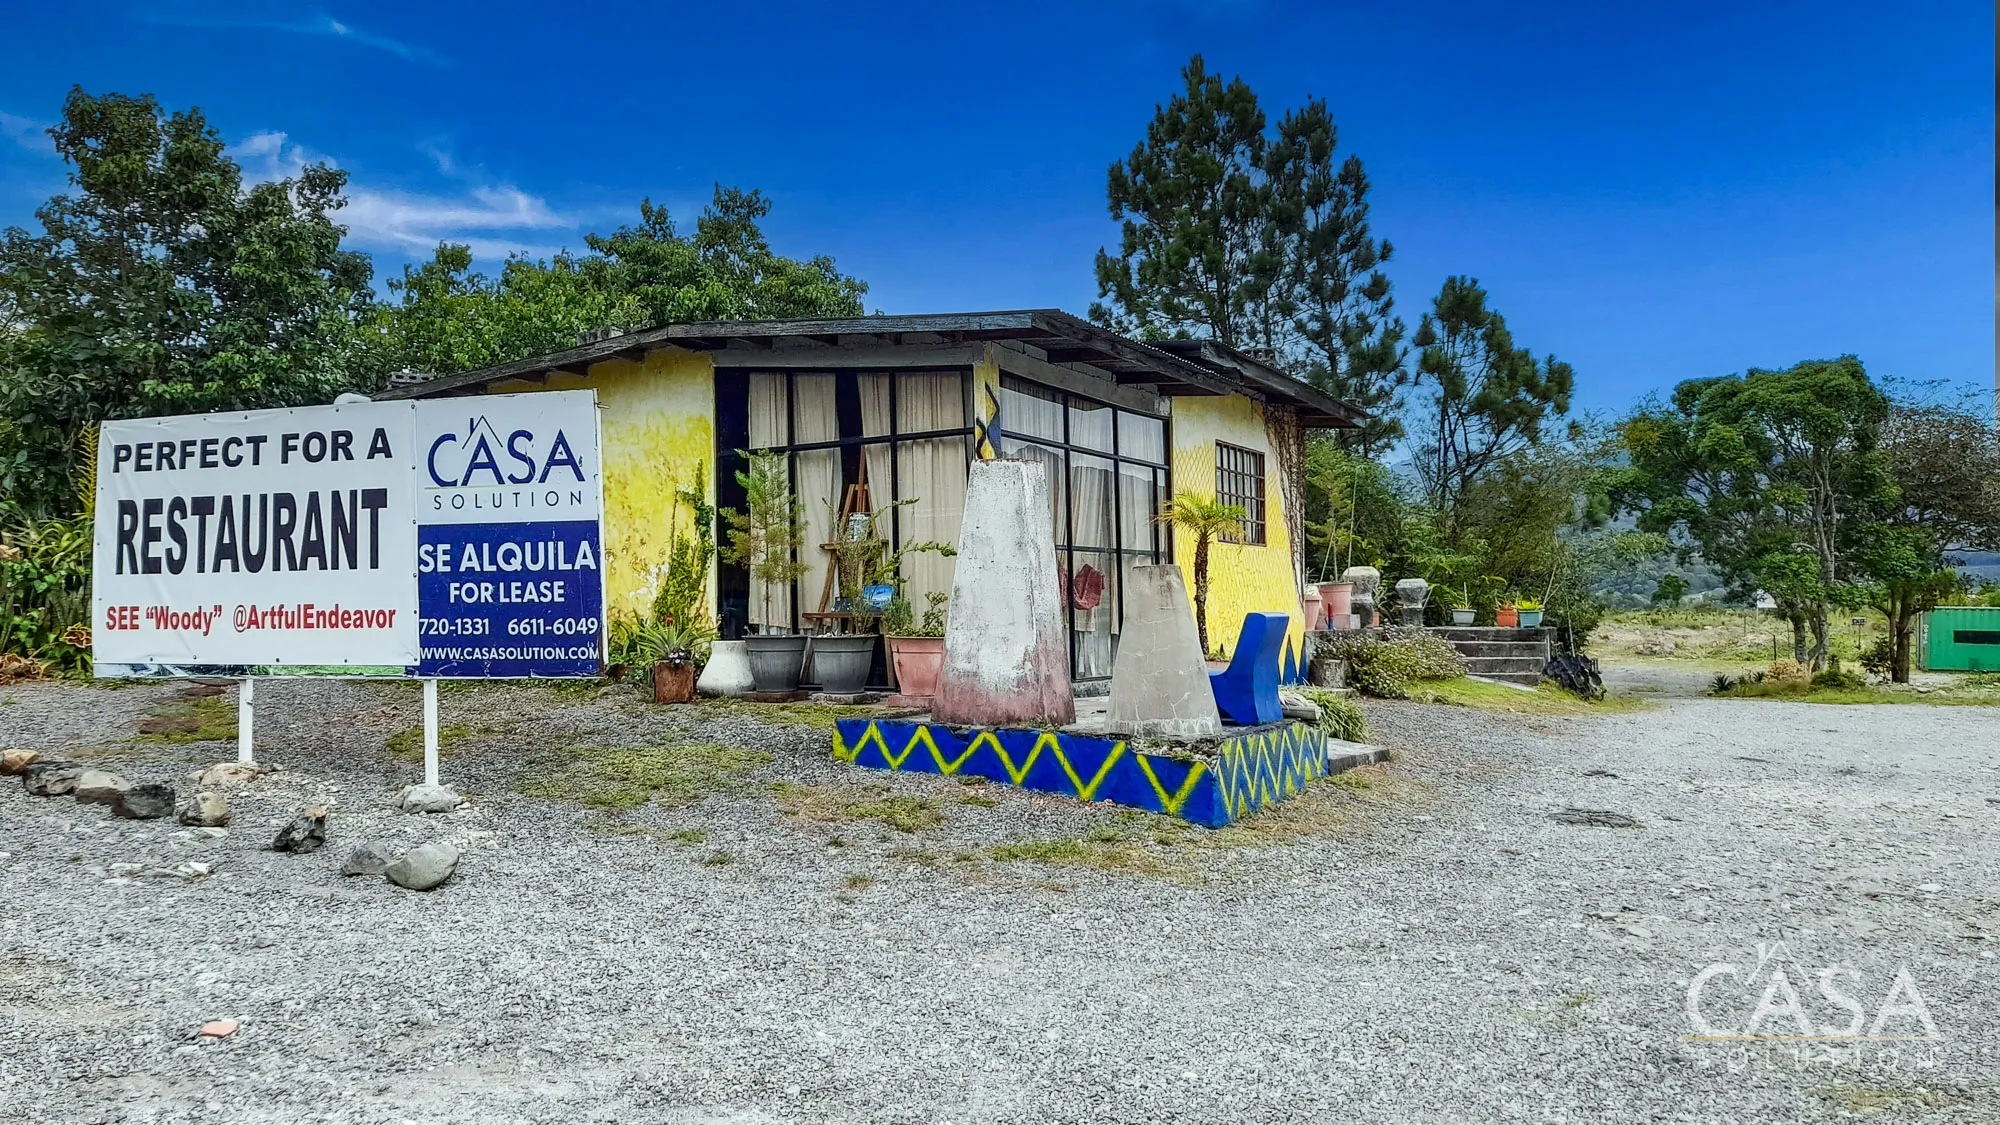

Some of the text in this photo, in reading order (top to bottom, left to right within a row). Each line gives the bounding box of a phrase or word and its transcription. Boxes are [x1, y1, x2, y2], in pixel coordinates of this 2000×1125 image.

[112, 427, 393, 473] PERFECT FOR A
[427, 428, 586, 487] CASA
[433, 490, 582, 510] SOLUTION
[115, 487, 388, 576] RESTAURANT
[419, 540, 597, 573] SE ALQUILA
[450, 581, 565, 604] FOR LEASE
[105, 606, 140, 631] SEE
[232, 603, 397, 633] @ArtfulEndeavor
[419, 617, 599, 636] 720-1331 6611-6049
[420, 646, 600, 661] WWW.CASASOLUTION.COM
